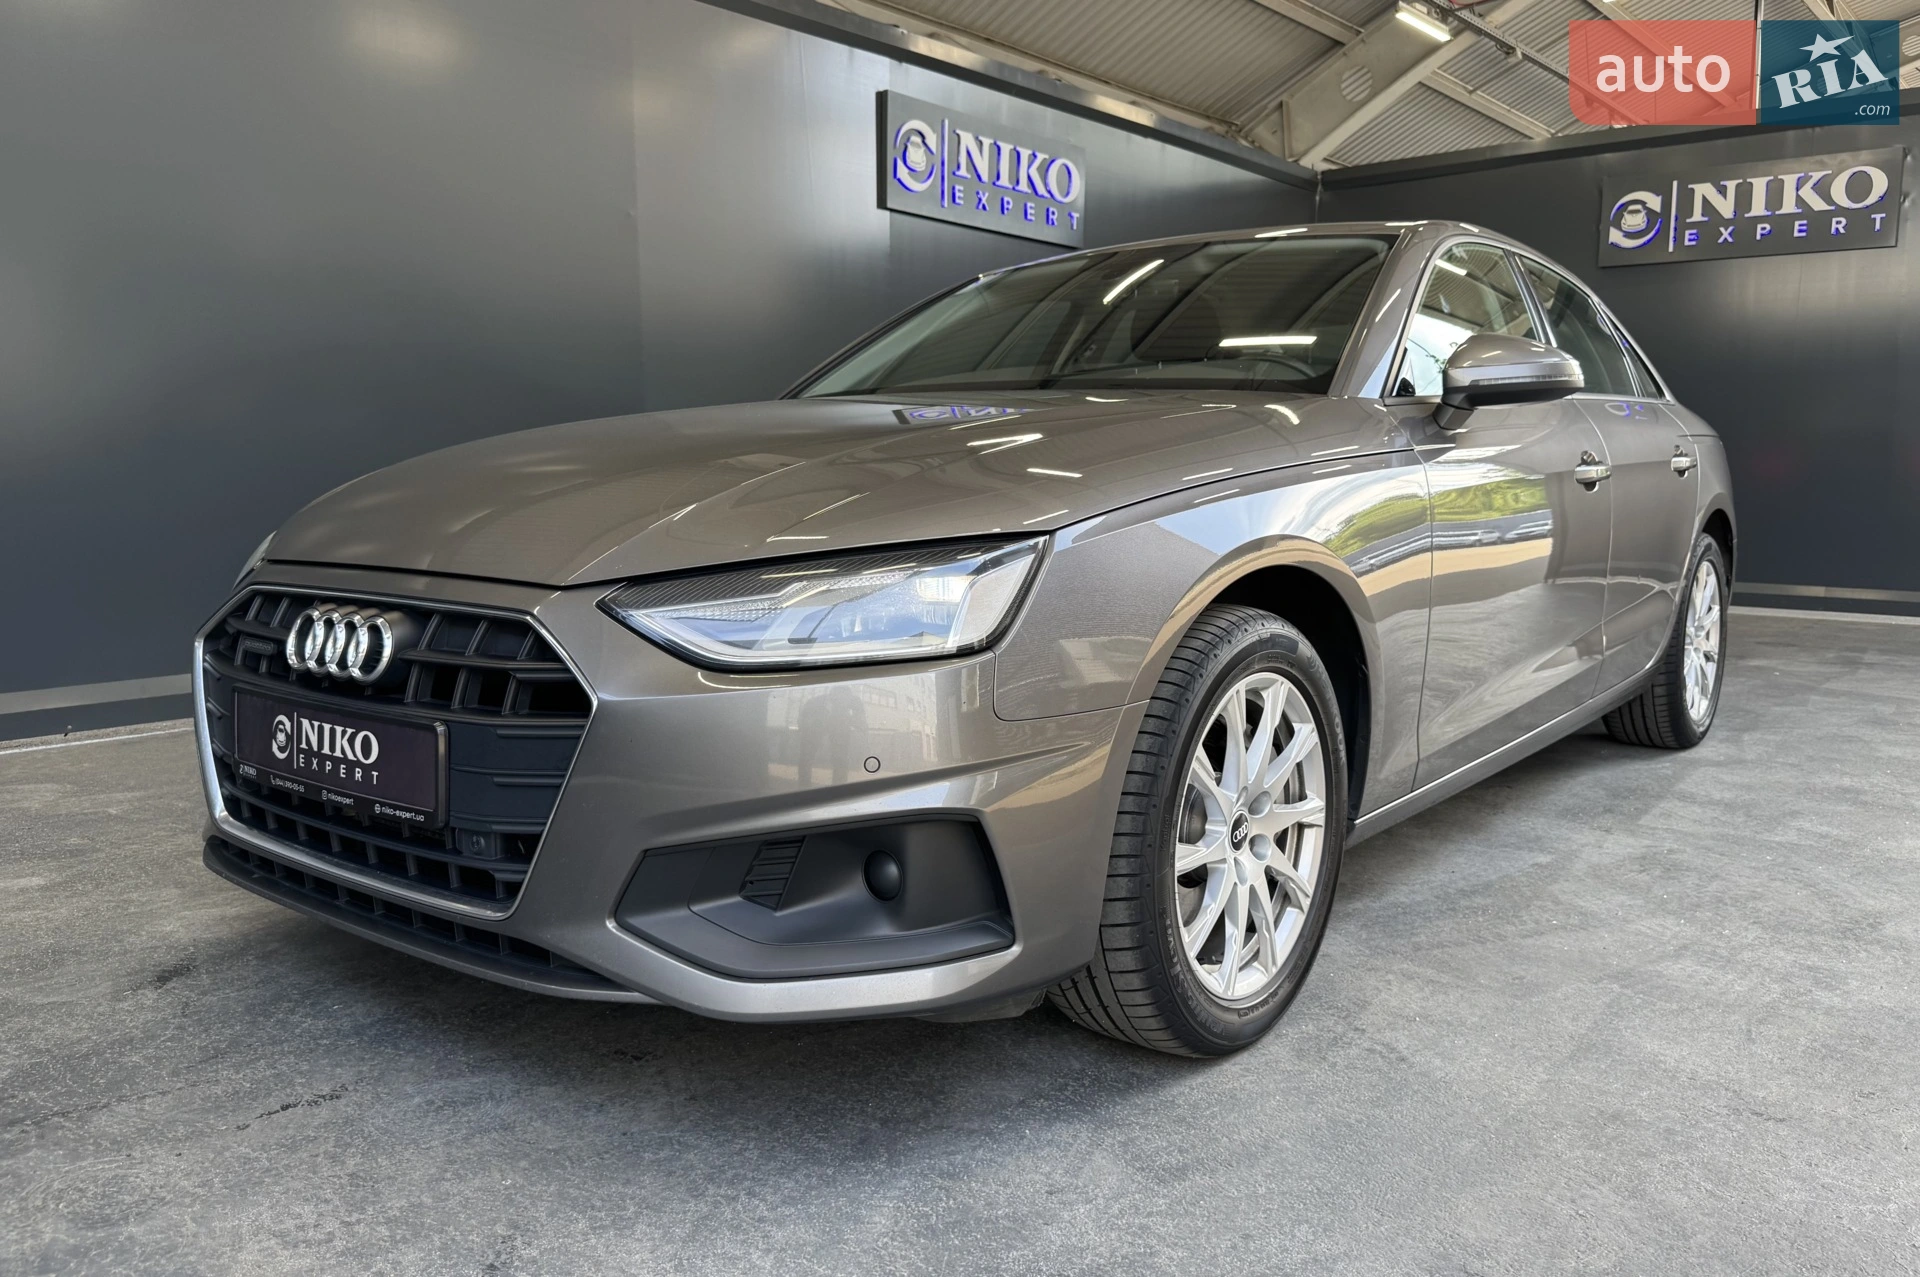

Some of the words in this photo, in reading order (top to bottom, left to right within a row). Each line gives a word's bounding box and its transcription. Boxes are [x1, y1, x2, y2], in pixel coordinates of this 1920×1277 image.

[953, 129, 1081, 204] NIKO
[952, 184, 1080, 231] EXPERT
[1685, 165, 1889, 223] NIKO
[1684, 213, 1886, 247] EXPERT
[299, 717, 379, 764] NIKO
[299, 754, 379, 785] EXPERT
[327, 792, 354, 806] nikoexpert
[381, 806, 425, 821] niko-expert.ua
